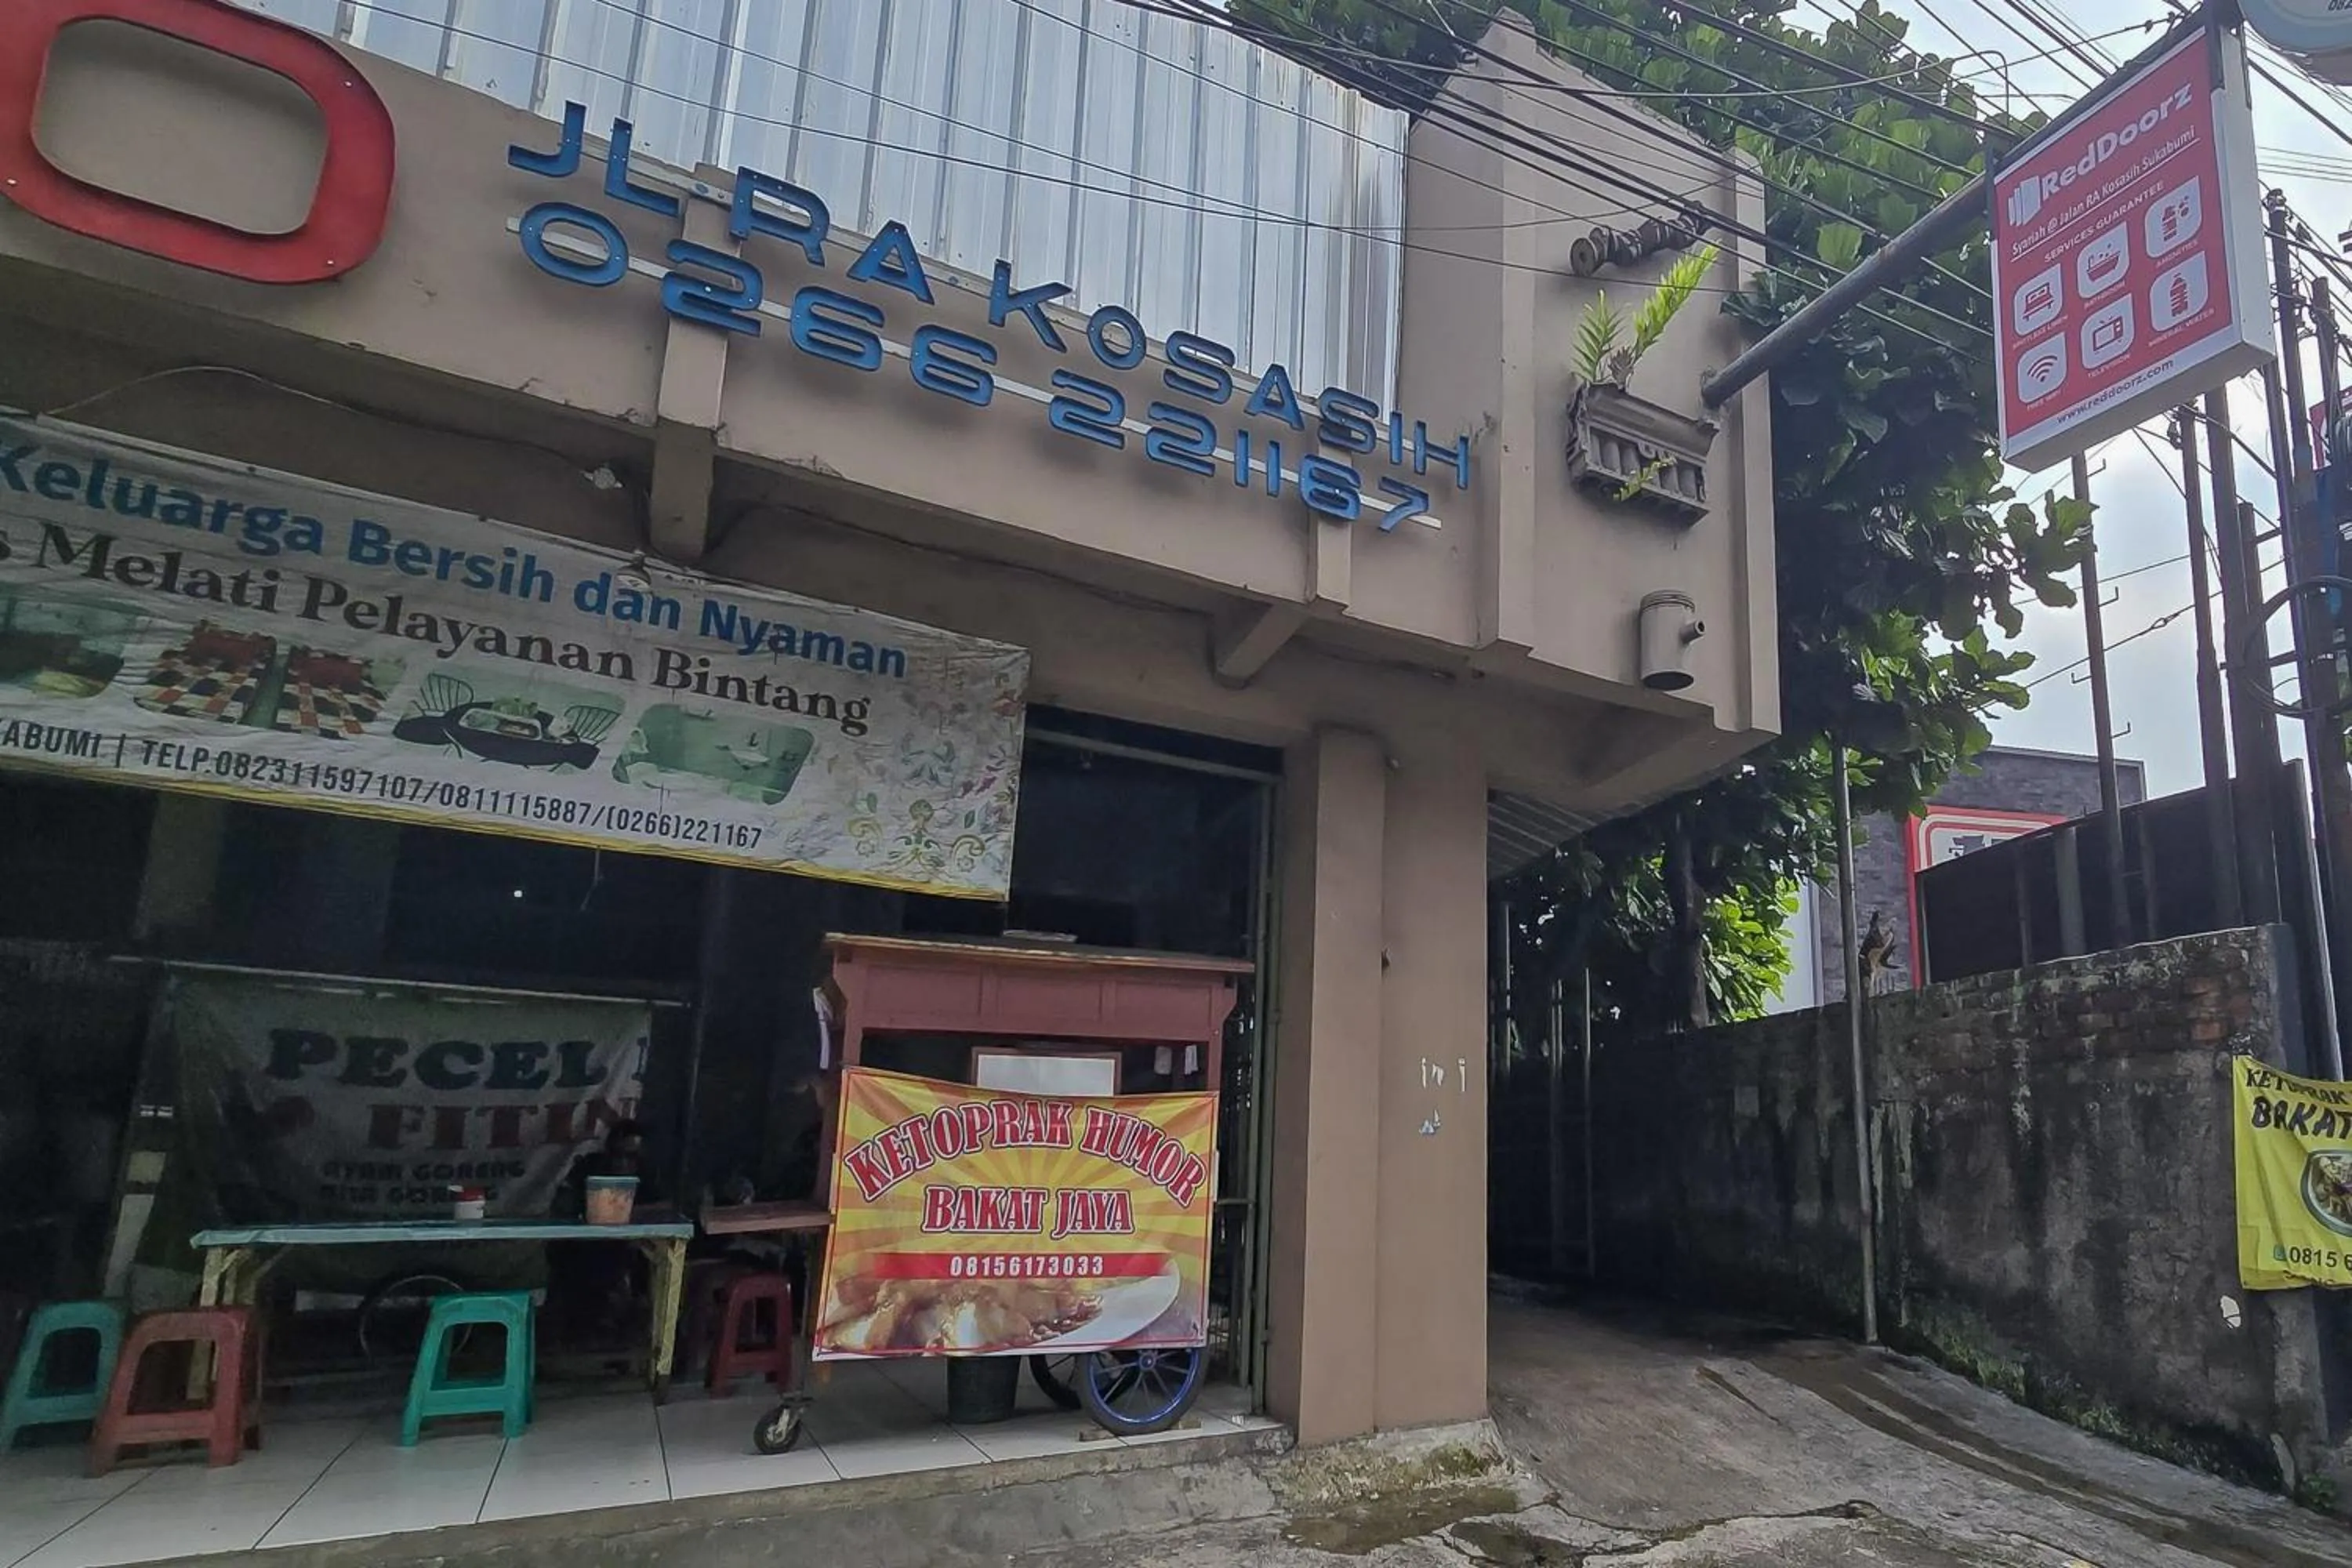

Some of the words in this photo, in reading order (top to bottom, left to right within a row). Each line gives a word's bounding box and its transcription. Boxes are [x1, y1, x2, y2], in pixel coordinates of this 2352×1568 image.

[2042, 83, 2193, 201] RedDoorz
[2085, 190, 2101, 210] RA
[2102, 164, 2140, 200] Kosasih
[2141, 125, 2195, 171] Sukabumi
[2043, 226, 2095, 263] SERVICES
[2096, 181, 2164, 229] GUARANTEE
[508, 100, 681, 216] JL
[729, 165, 935, 305] RA
[988, 258, 1469, 490] KOSASIH
[519, 201, 997, 407] 0266
[1048, 368, 1430, 533] 221167
[2056, 358, 2175, 424] www.reddoorz.com
[0, 438, 324, 557] Keluarga
[347, 517, 555, 604] Bersih
[573, 572, 681, 631] dan
[699, 598, 907, 678] Nyaman
[28, 522, 280, 613] Melati
[297, 574, 637, 682] Pelayanan
[651, 646, 872, 737] Bintang
[0, 717, 102, 758] ABUMI
[264, 1027, 609, 1091] PECEL
[844, 1099, 1075, 1202] KETOPRAK
[1080, 1105, 1207, 1208] HUMOR
[920, 1185, 1049, 1236] BAKAT
[1050, 1188, 1135, 1240] JAYA
[2289, 1246, 2337, 1268] 0815
